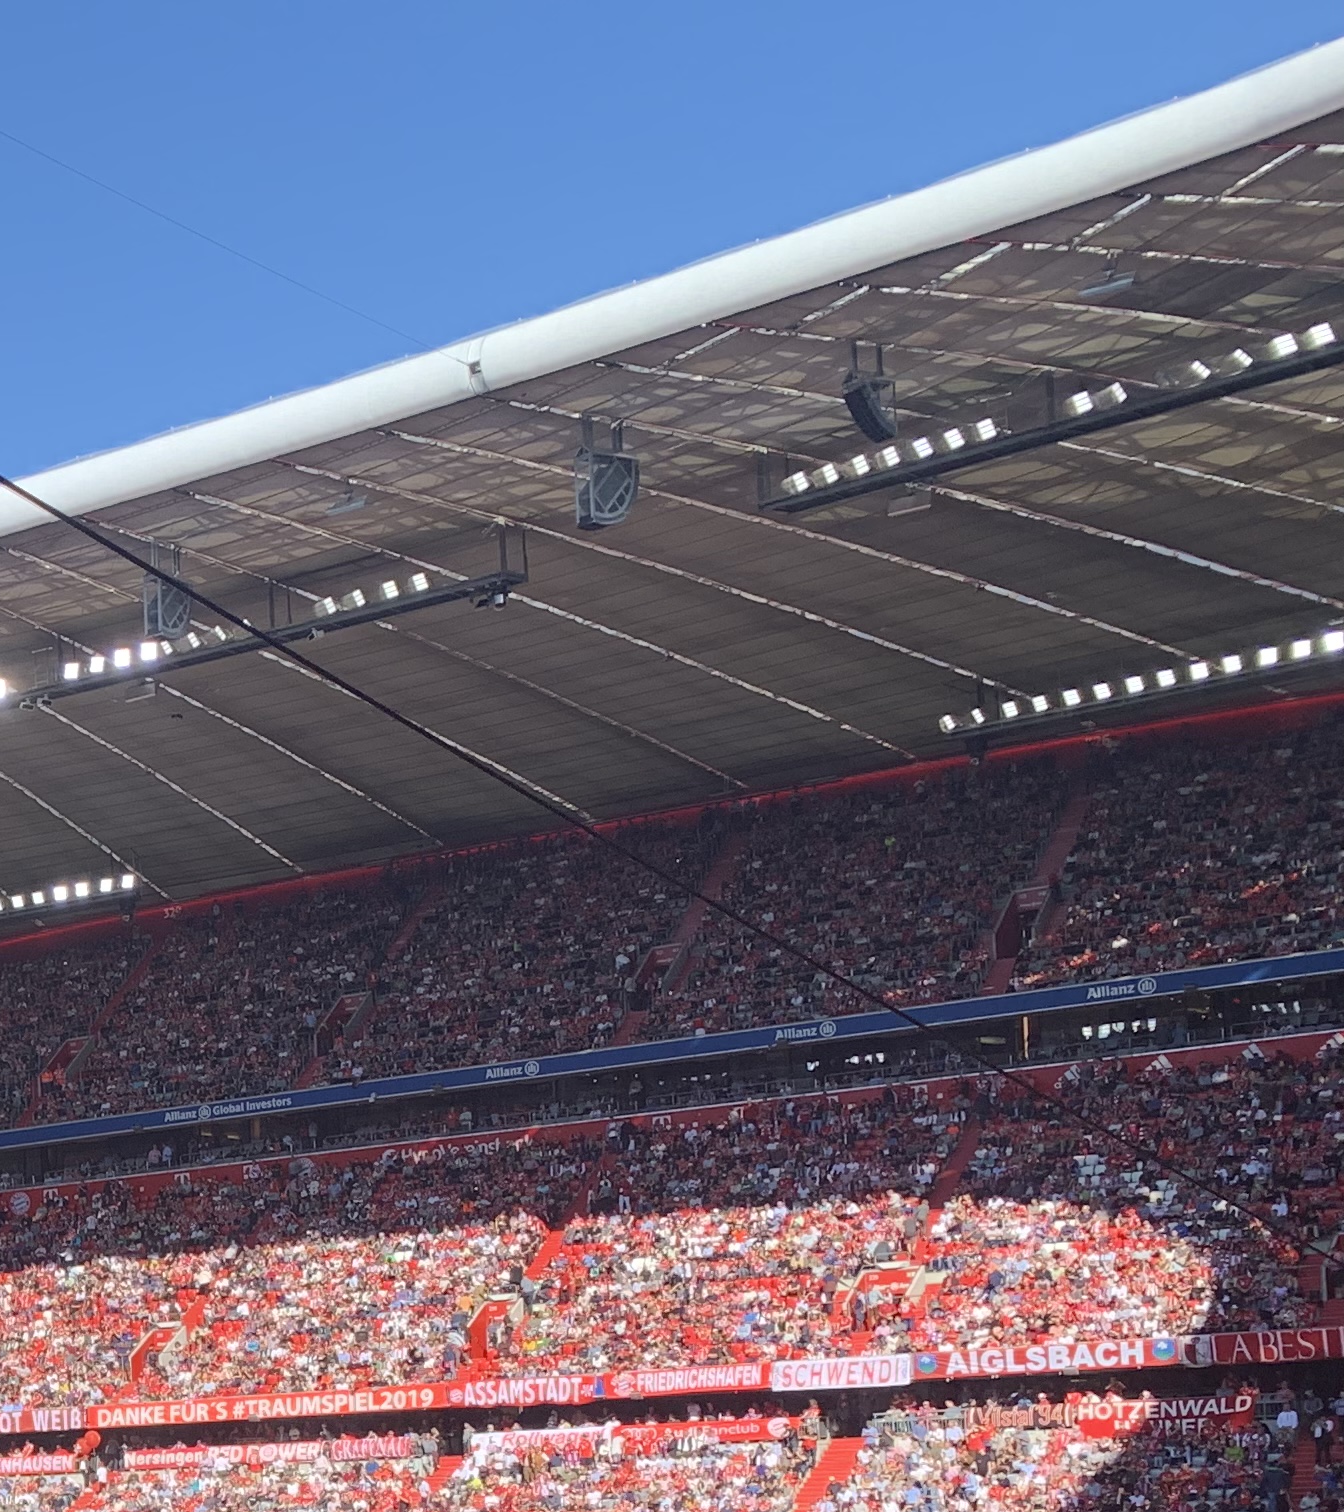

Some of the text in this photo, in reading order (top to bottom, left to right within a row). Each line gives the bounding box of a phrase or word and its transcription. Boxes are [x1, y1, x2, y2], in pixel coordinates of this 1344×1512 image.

[1086, 984, 1136, 1000] Allianz
[775, 1026, 818, 1042] Allianz
[485, 1066, 524, 1079] Allianz
[164, 1097, 292, 1122] Allianz Global Investors
[946, 1341, 1145, 1376] AIGLSBACH
[636, 1366, 762, 1392] FRIEDRICHSHAFEN
[781, 1358, 900, 1389] SCHWENDI
[464, 1377, 583, 1405] ASSAMSTADT
[97, 1404, 165, 1427] DANKE
[232, 1388, 435, 1419] #TRAUMSPIEL2019
[976, 1406, 1034, 1428] Vilstal
[1077, 1395, 1253, 1421] HOTZENWALD
[124, 1446, 207, 1467] Nersingen
